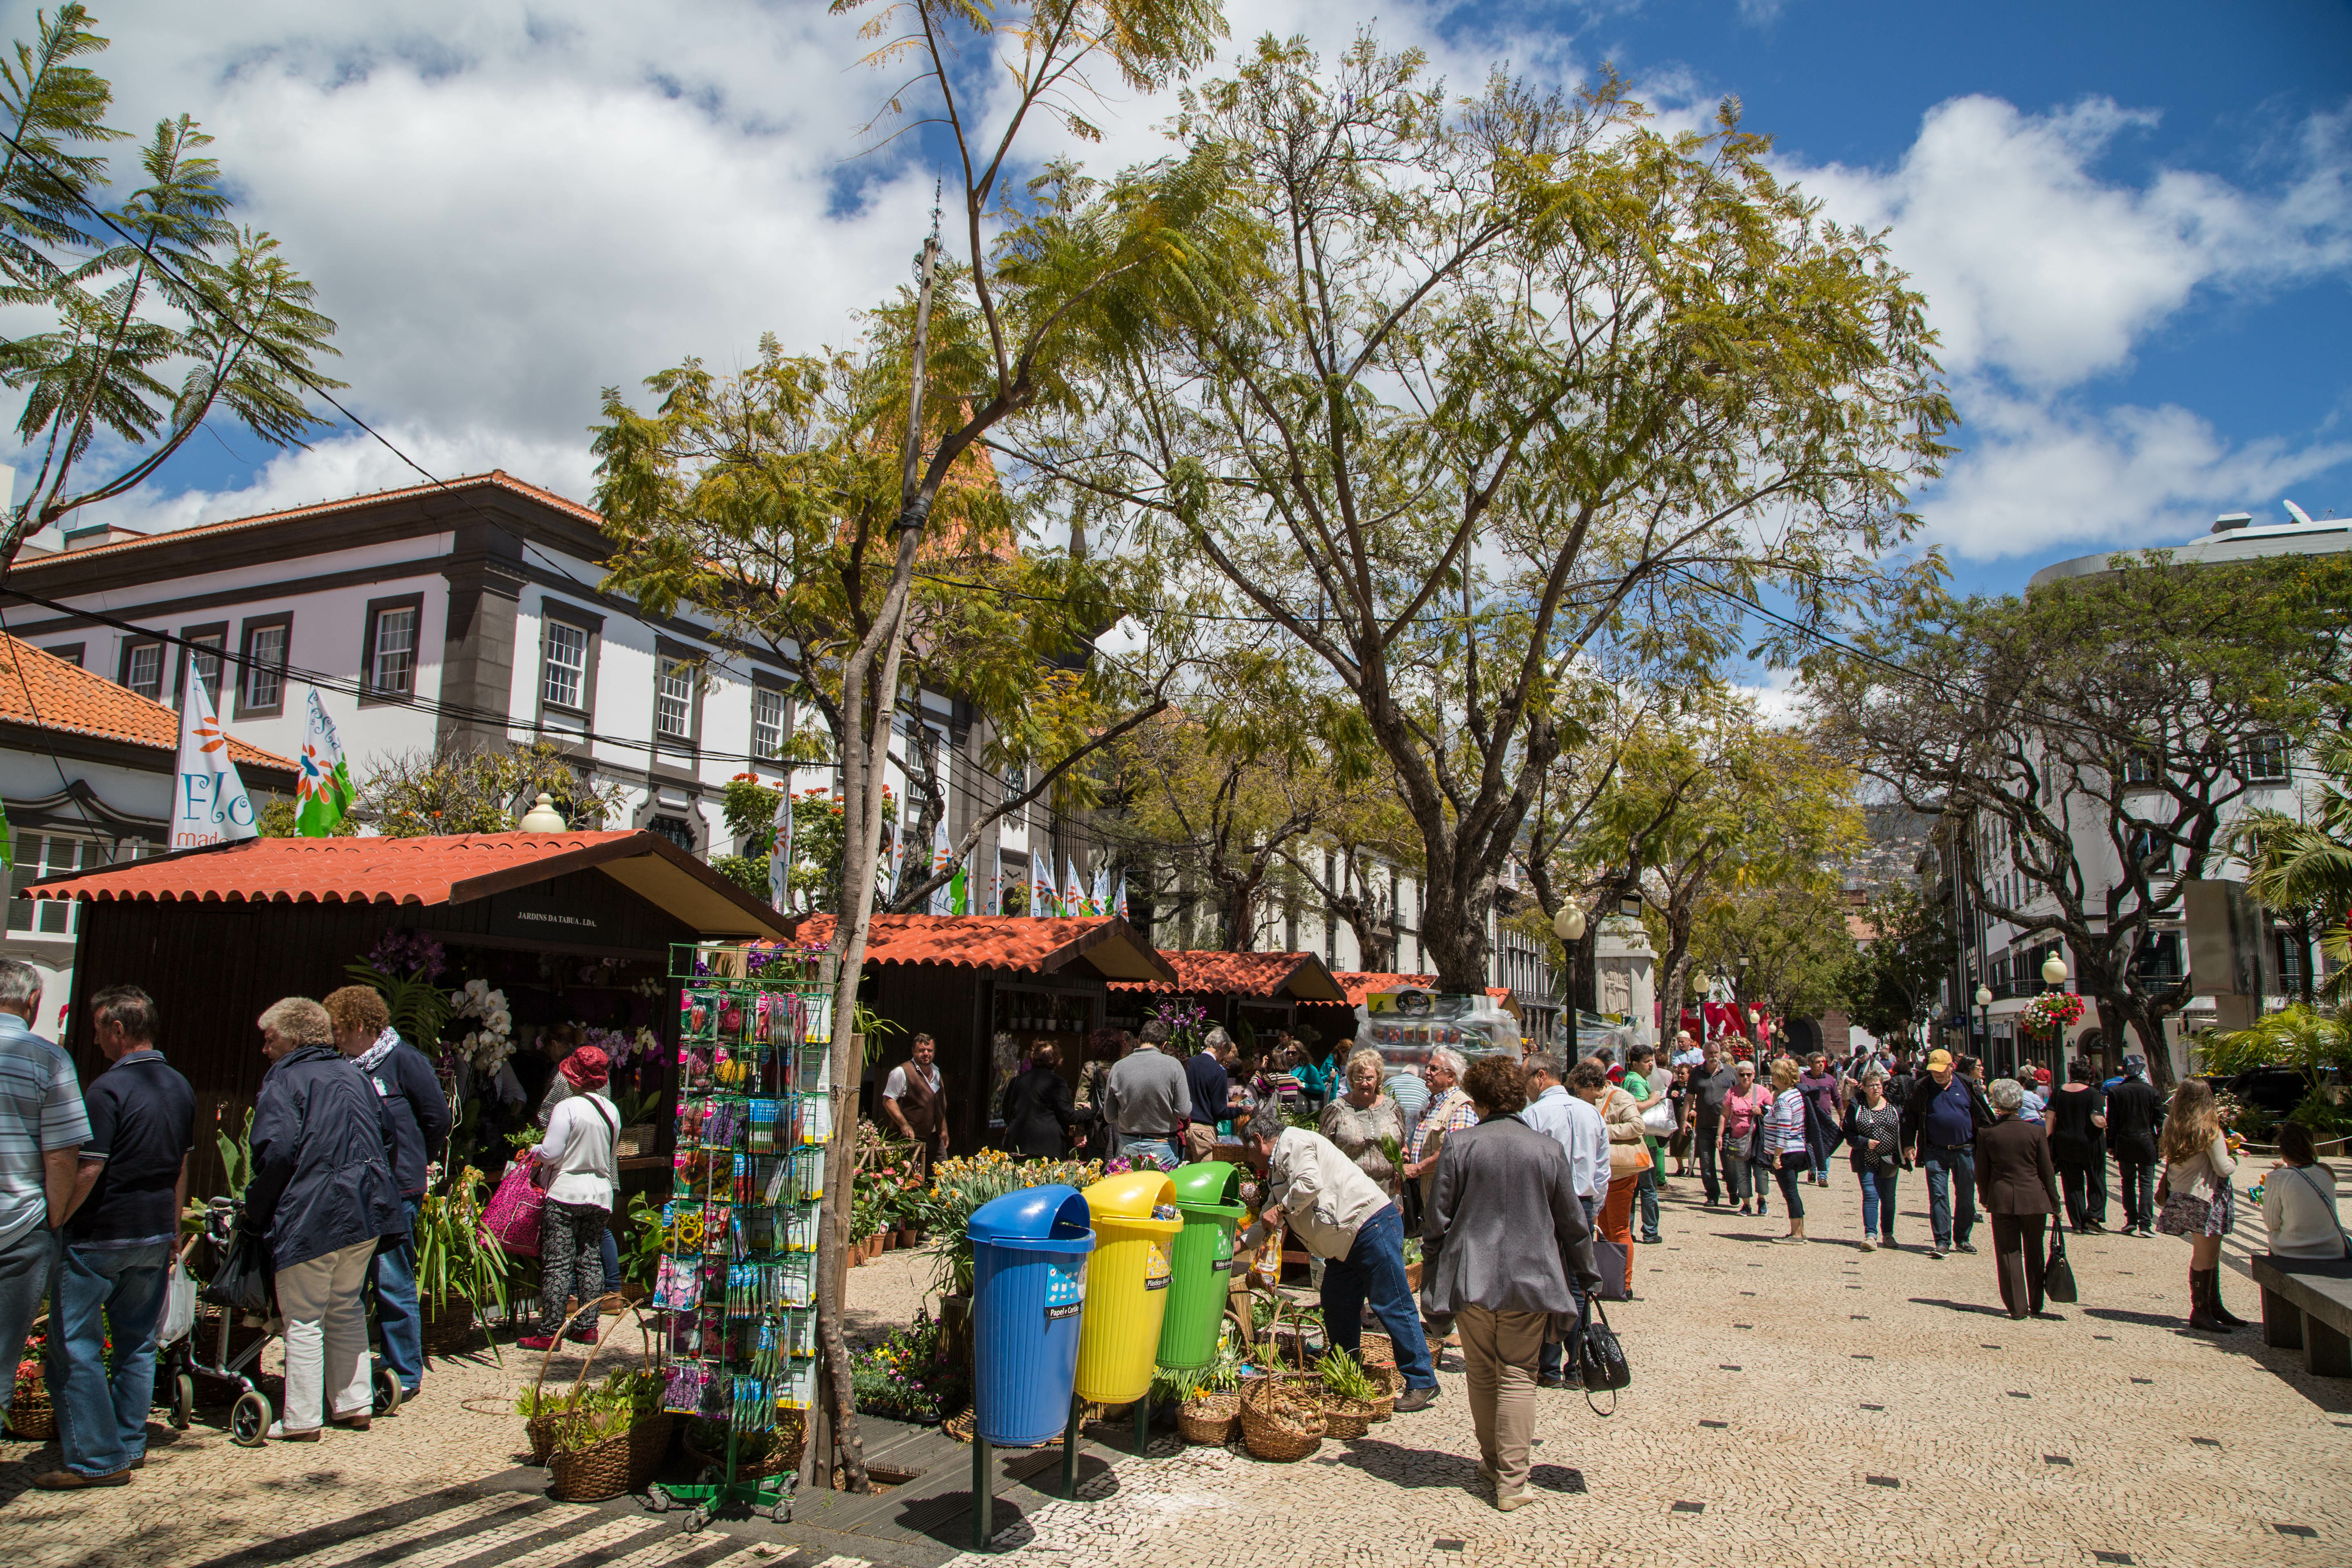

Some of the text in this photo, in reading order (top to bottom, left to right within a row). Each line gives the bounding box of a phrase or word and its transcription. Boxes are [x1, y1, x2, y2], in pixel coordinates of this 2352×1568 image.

[518, 912, 547, 921] JARDINS
[583, 919, 597, 927] LDA.
[1050, 1307, 1064, 1316] Papel
[1068, 1305, 1079, 1314] Cartão
